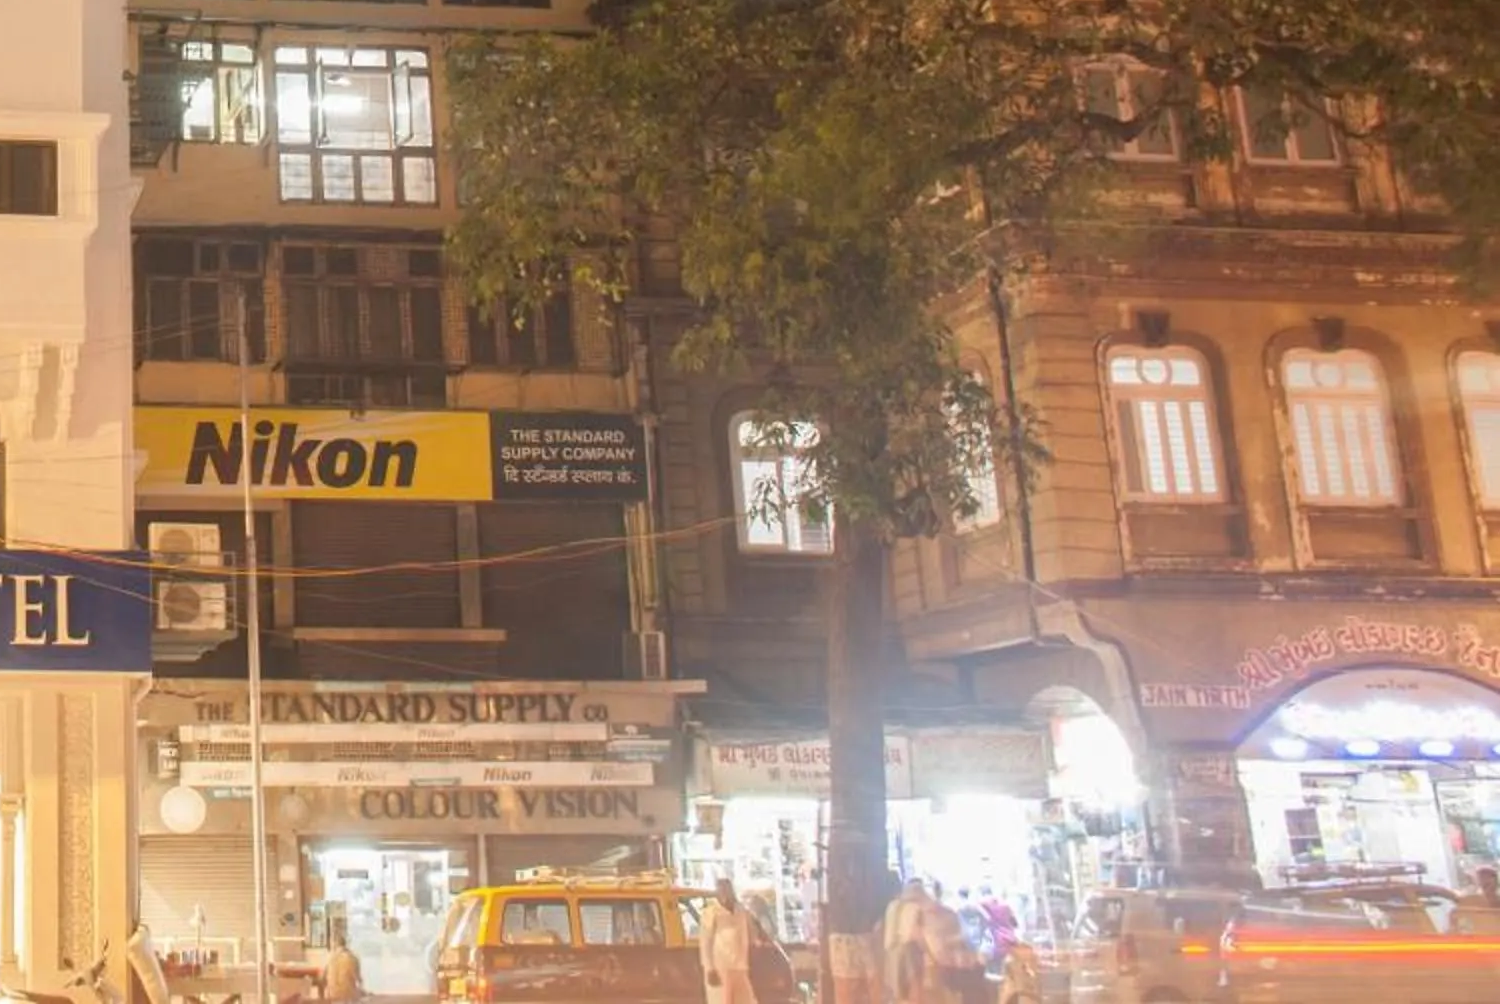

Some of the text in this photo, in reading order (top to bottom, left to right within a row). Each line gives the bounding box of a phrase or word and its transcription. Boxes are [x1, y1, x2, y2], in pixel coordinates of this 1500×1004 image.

[510, 428, 626, 444] THE STANDARD
[186, 419, 417, 488] Nikon
[501, 446, 636, 462] SUPPLY COMPANY
[195, 701, 234, 722] THE
[449, 691, 577, 723] SUPPLY
[1141, 683, 1188, 707] JAIN
[483, 766, 533, 782] Nikon
[360, 788, 640, 821] COLOUR VISION
